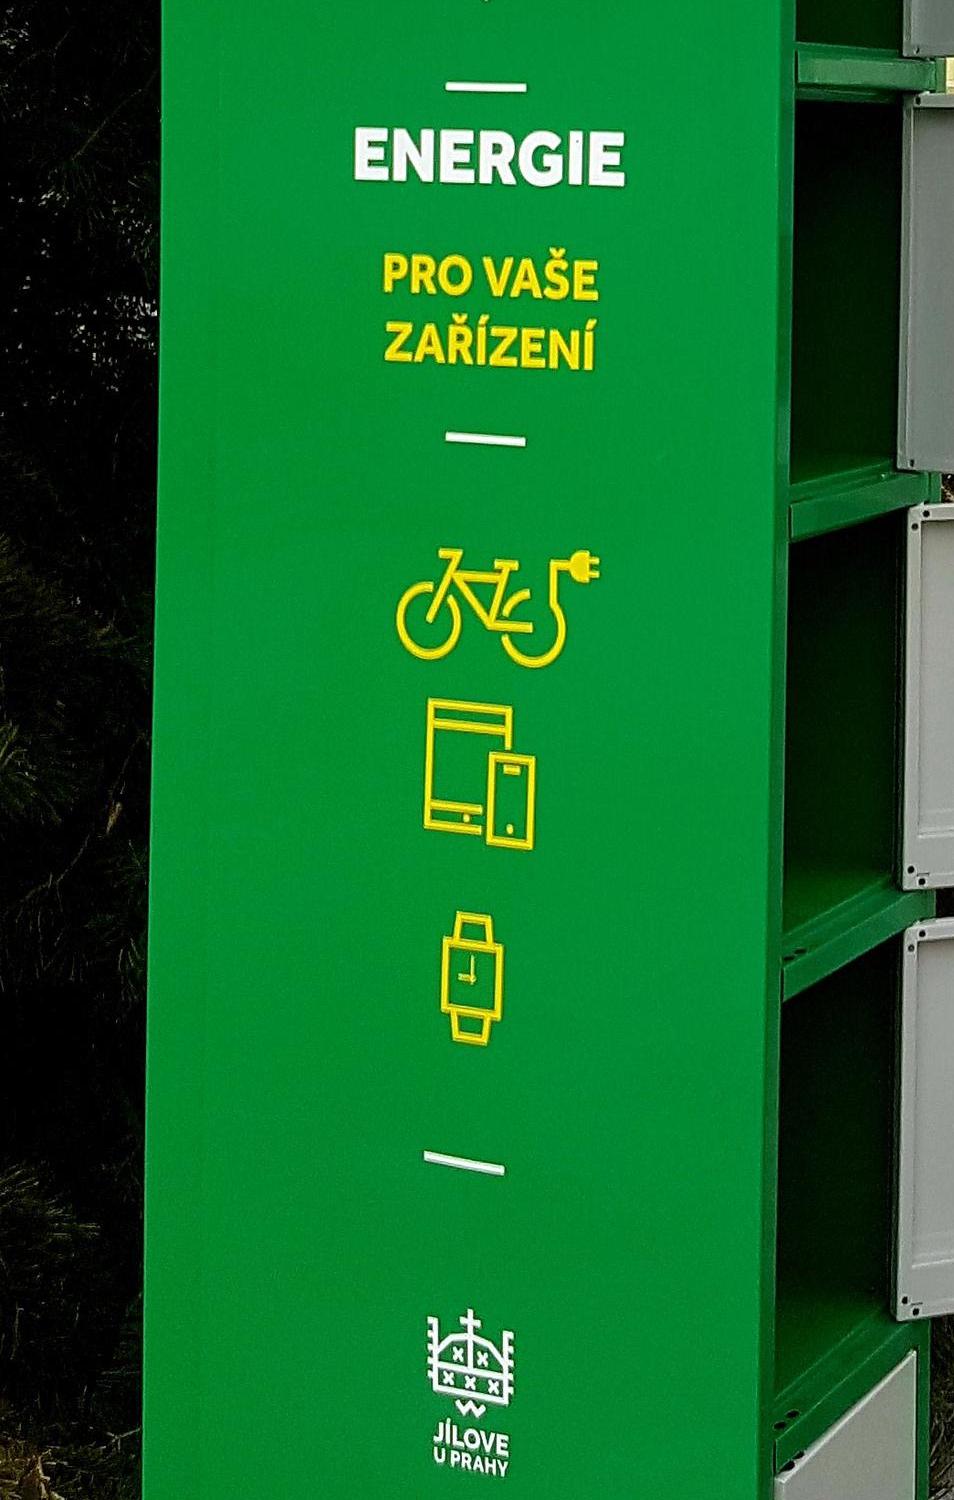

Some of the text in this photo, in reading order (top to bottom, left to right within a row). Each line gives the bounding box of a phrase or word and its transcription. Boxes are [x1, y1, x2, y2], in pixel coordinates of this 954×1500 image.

[353, 126, 626, 187] ENERGIE
[383, 246, 600, 301] PRO VAŠE
[384, 312, 598, 371] ZAŘÍZENÍ
[433, 1445, 509, 1478] U PRAHY
